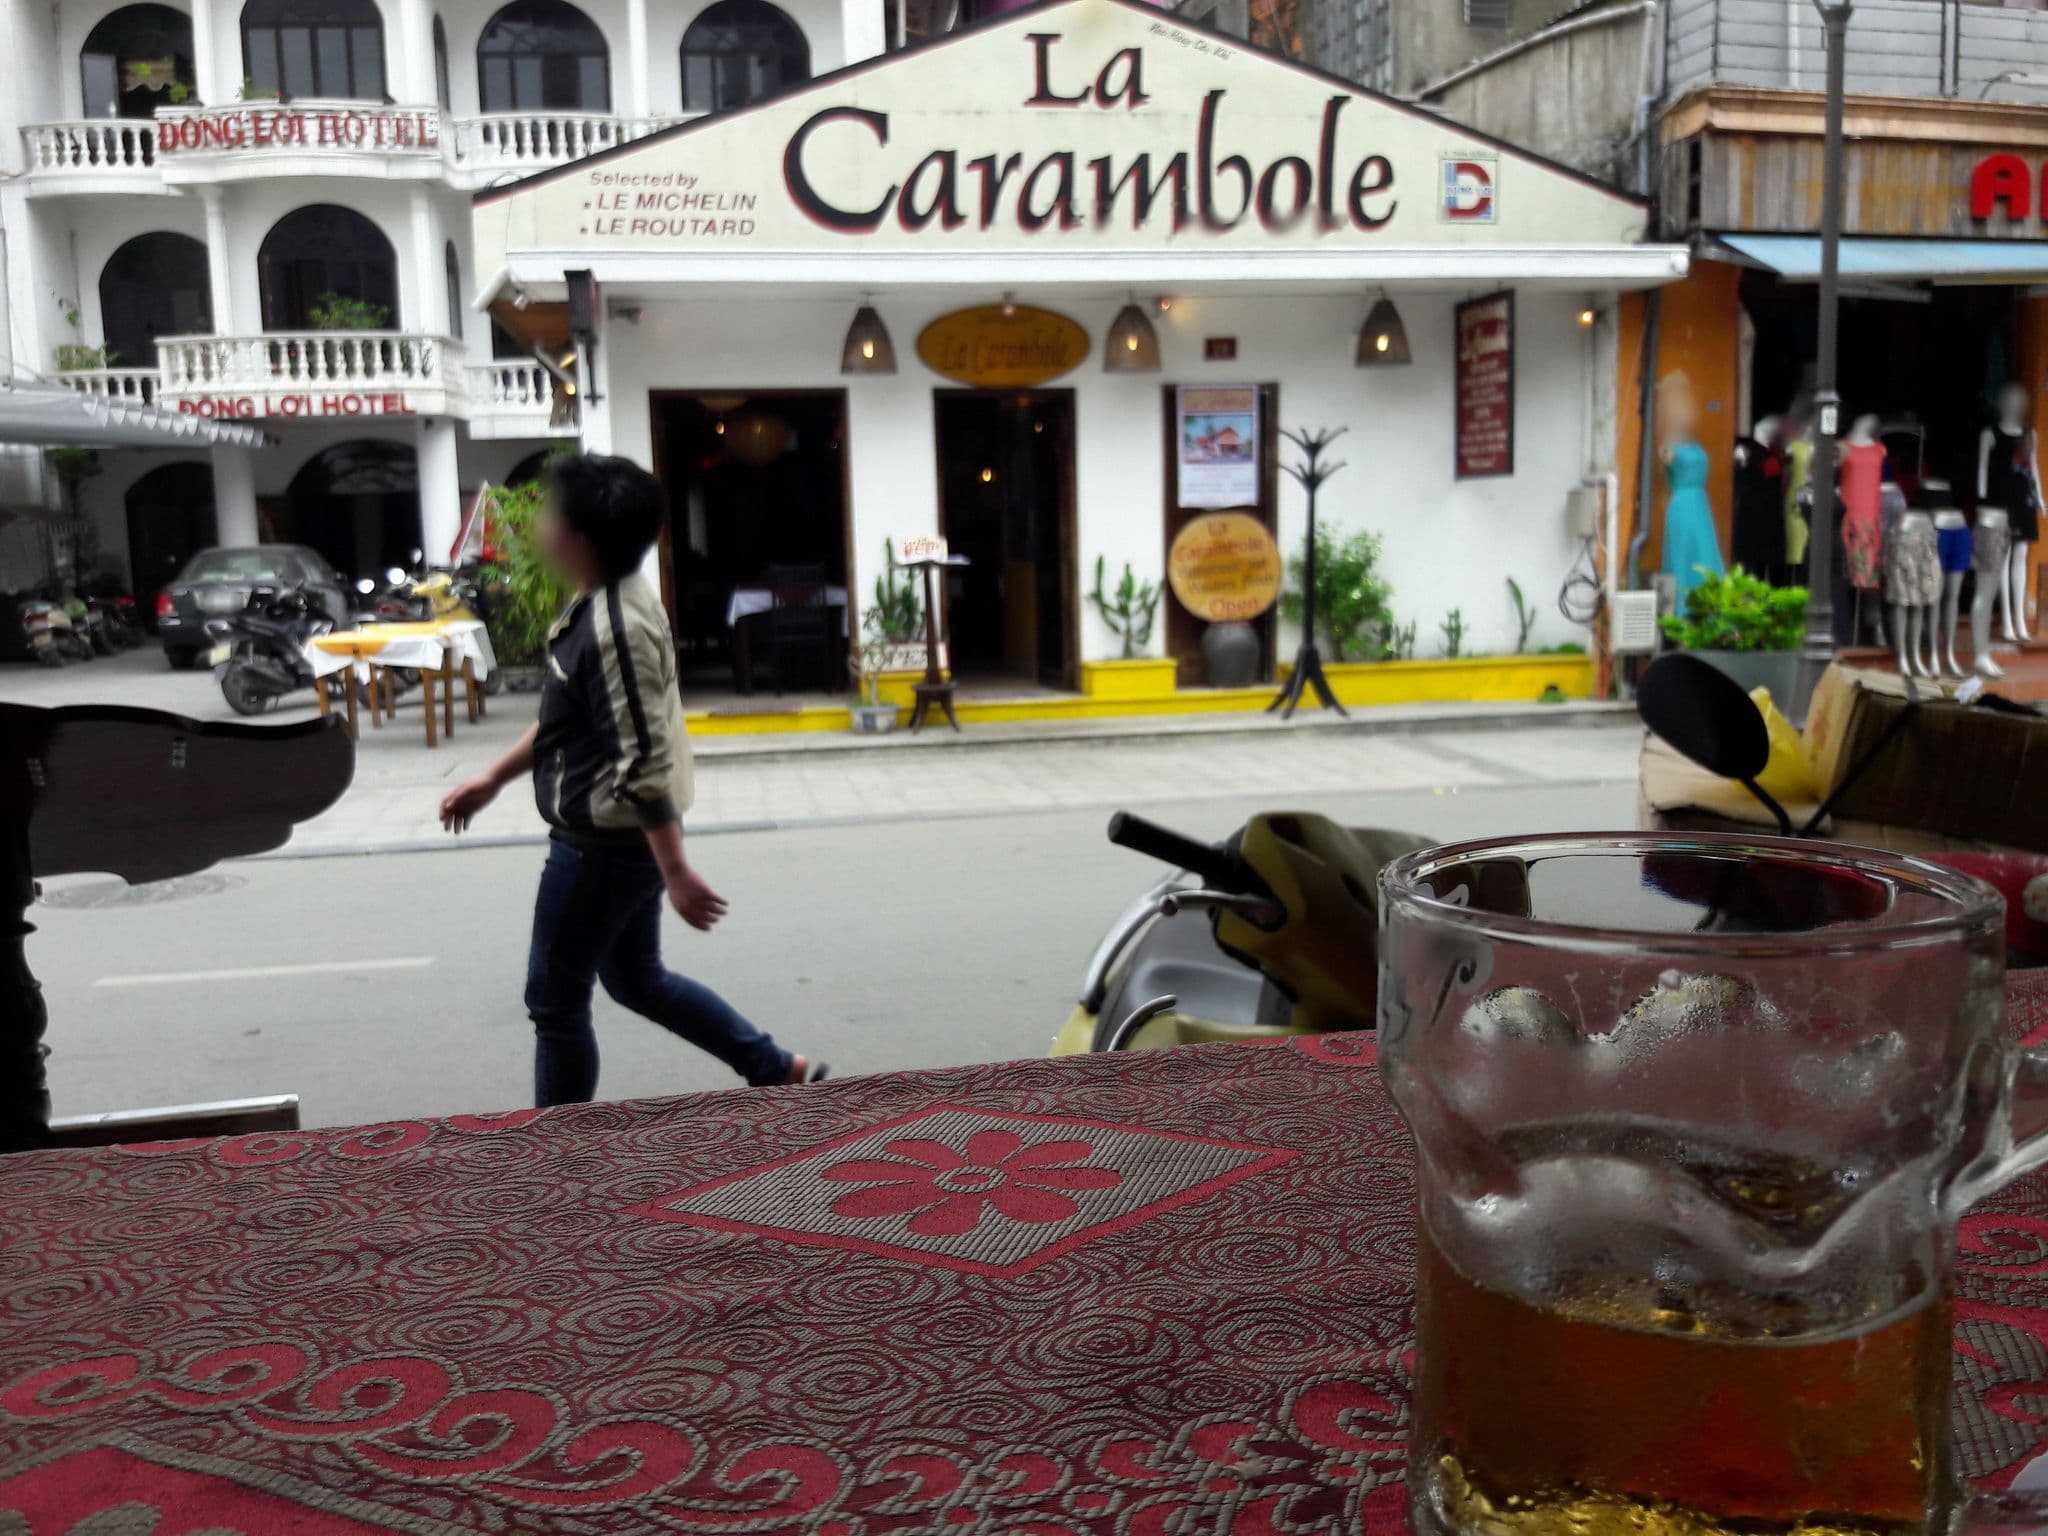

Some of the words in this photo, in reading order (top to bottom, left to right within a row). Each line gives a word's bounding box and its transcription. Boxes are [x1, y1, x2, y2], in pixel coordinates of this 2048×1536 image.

[1024, 32, 1151, 111] La
[783, 89, 1398, 235] Carambole
[590, 172, 674, 187] Selected
[677, 172, 699, 190] by
[598, 192, 629, 210] LE
[634, 192, 758, 210] MICHELIN
[594, 218, 626, 235] LE
[630, 218, 757, 236] ROUTARD
[322, 392, 417, 416] HOTEL
